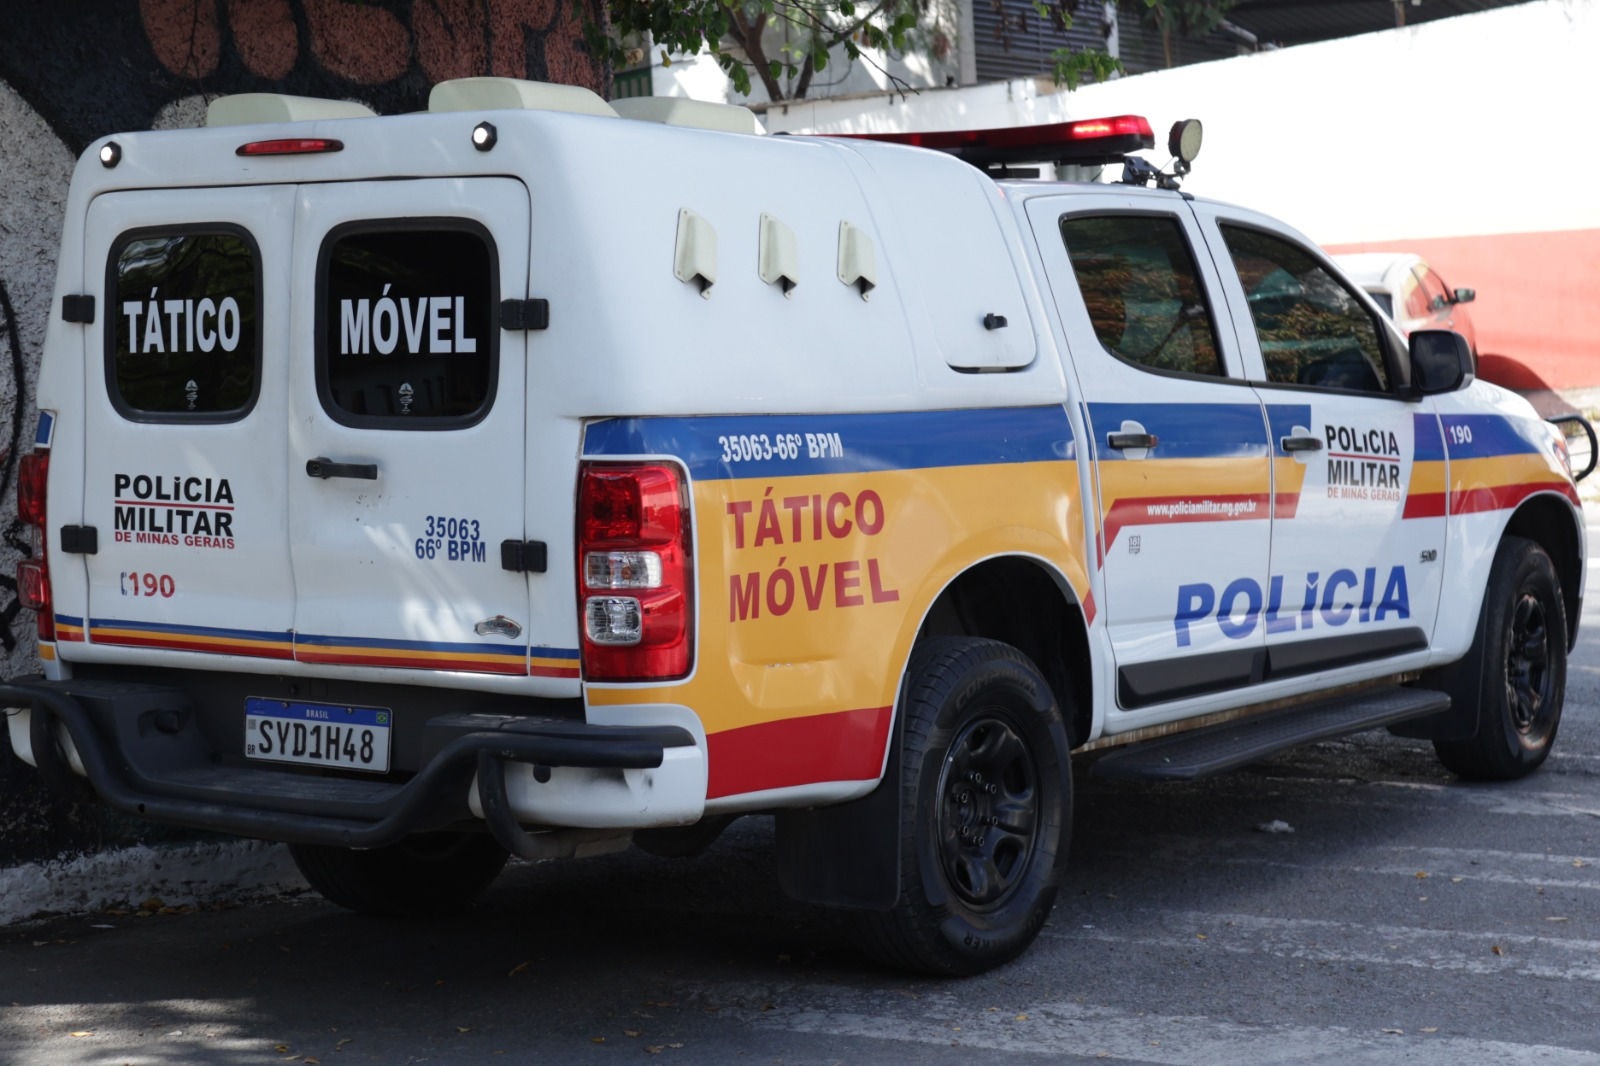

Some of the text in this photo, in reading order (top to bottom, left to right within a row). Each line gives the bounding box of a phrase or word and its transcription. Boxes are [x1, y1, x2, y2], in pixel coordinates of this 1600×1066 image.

[123, 286, 241, 354] TÁTICO
[340, 283, 477, 355] MÓVEL
[805, 432, 844, 459] BPM
[1450, 425, 1472, 444] 190
[1327, 459, 1400, 489] MILITAR
[1327, 487, 1400, 501] DE MINAS GERAIS
[114, 506, 233, 537] MILITAR
[726, 486, 885, 549] TÁTICO
[1147, 499, 1257, 518] www.policiamilitar.mg.gov.br
[115, 531, 235, 549] DE MINAS GERAIS
[425, 515, 480, 541] 35063
[448, 540, 486, 563] BPM
[128, 571, 175, 598] 190
[729, 557, 900, 623] MÓVEL
[305, 708, 329, 719] BRASIL
[247, 744, 256, 755] BR
[258, 719, 374, 764] SYD1H48
